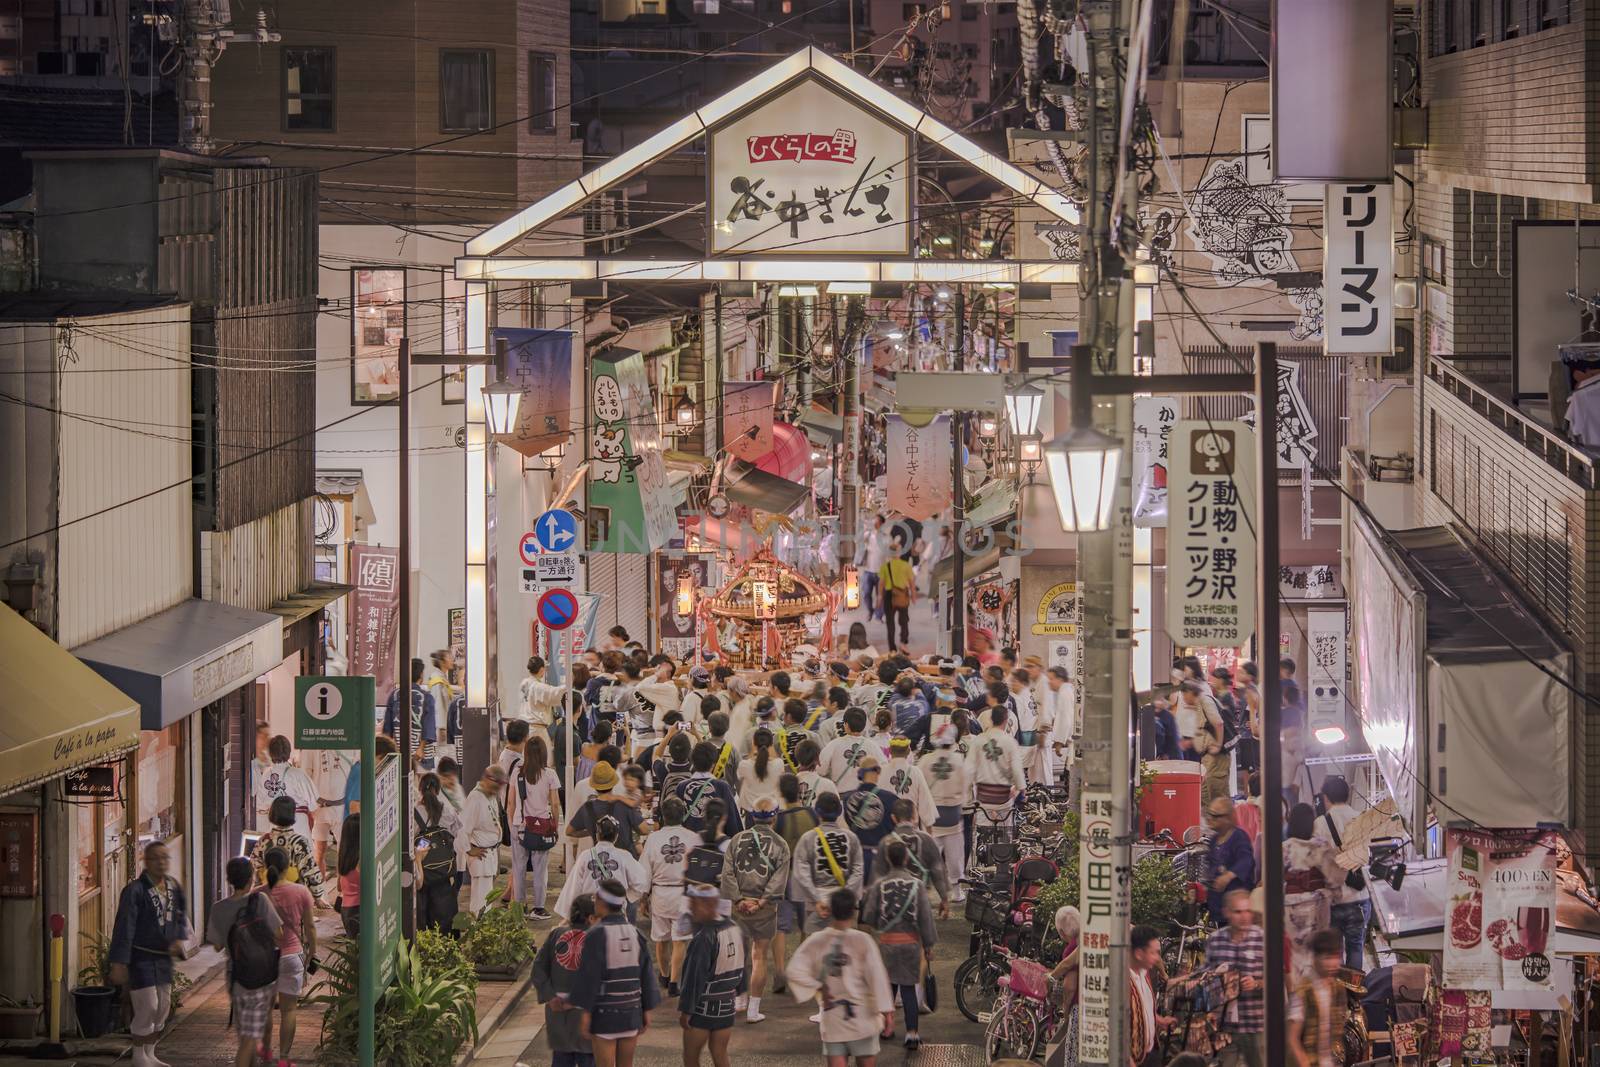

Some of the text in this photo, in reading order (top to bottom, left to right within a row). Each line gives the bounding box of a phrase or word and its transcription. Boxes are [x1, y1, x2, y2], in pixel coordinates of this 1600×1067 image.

[748, 128, 856, 163] ひぐらしの里
[726, 156, 895, 239] 谷中ぎんざ
[597, 383, 607, 415] ぐるい
[606, 380, 618, 417] しにもの
[906, 427, 919, 508] 谷中ぎんざ
[1186, 480, 1208, 599] クリニック
[1212, 480, 1237, 600] 動物・野沢
[538, 556, 576, 567] 自転車を除く
[538, 566, 575, 575] 一方通行
[365, 606, 379, 676] 和雑貨・カフ
[1183, 628, 1238, 639] 3894-7739
[85, 731, 93, 746] la
